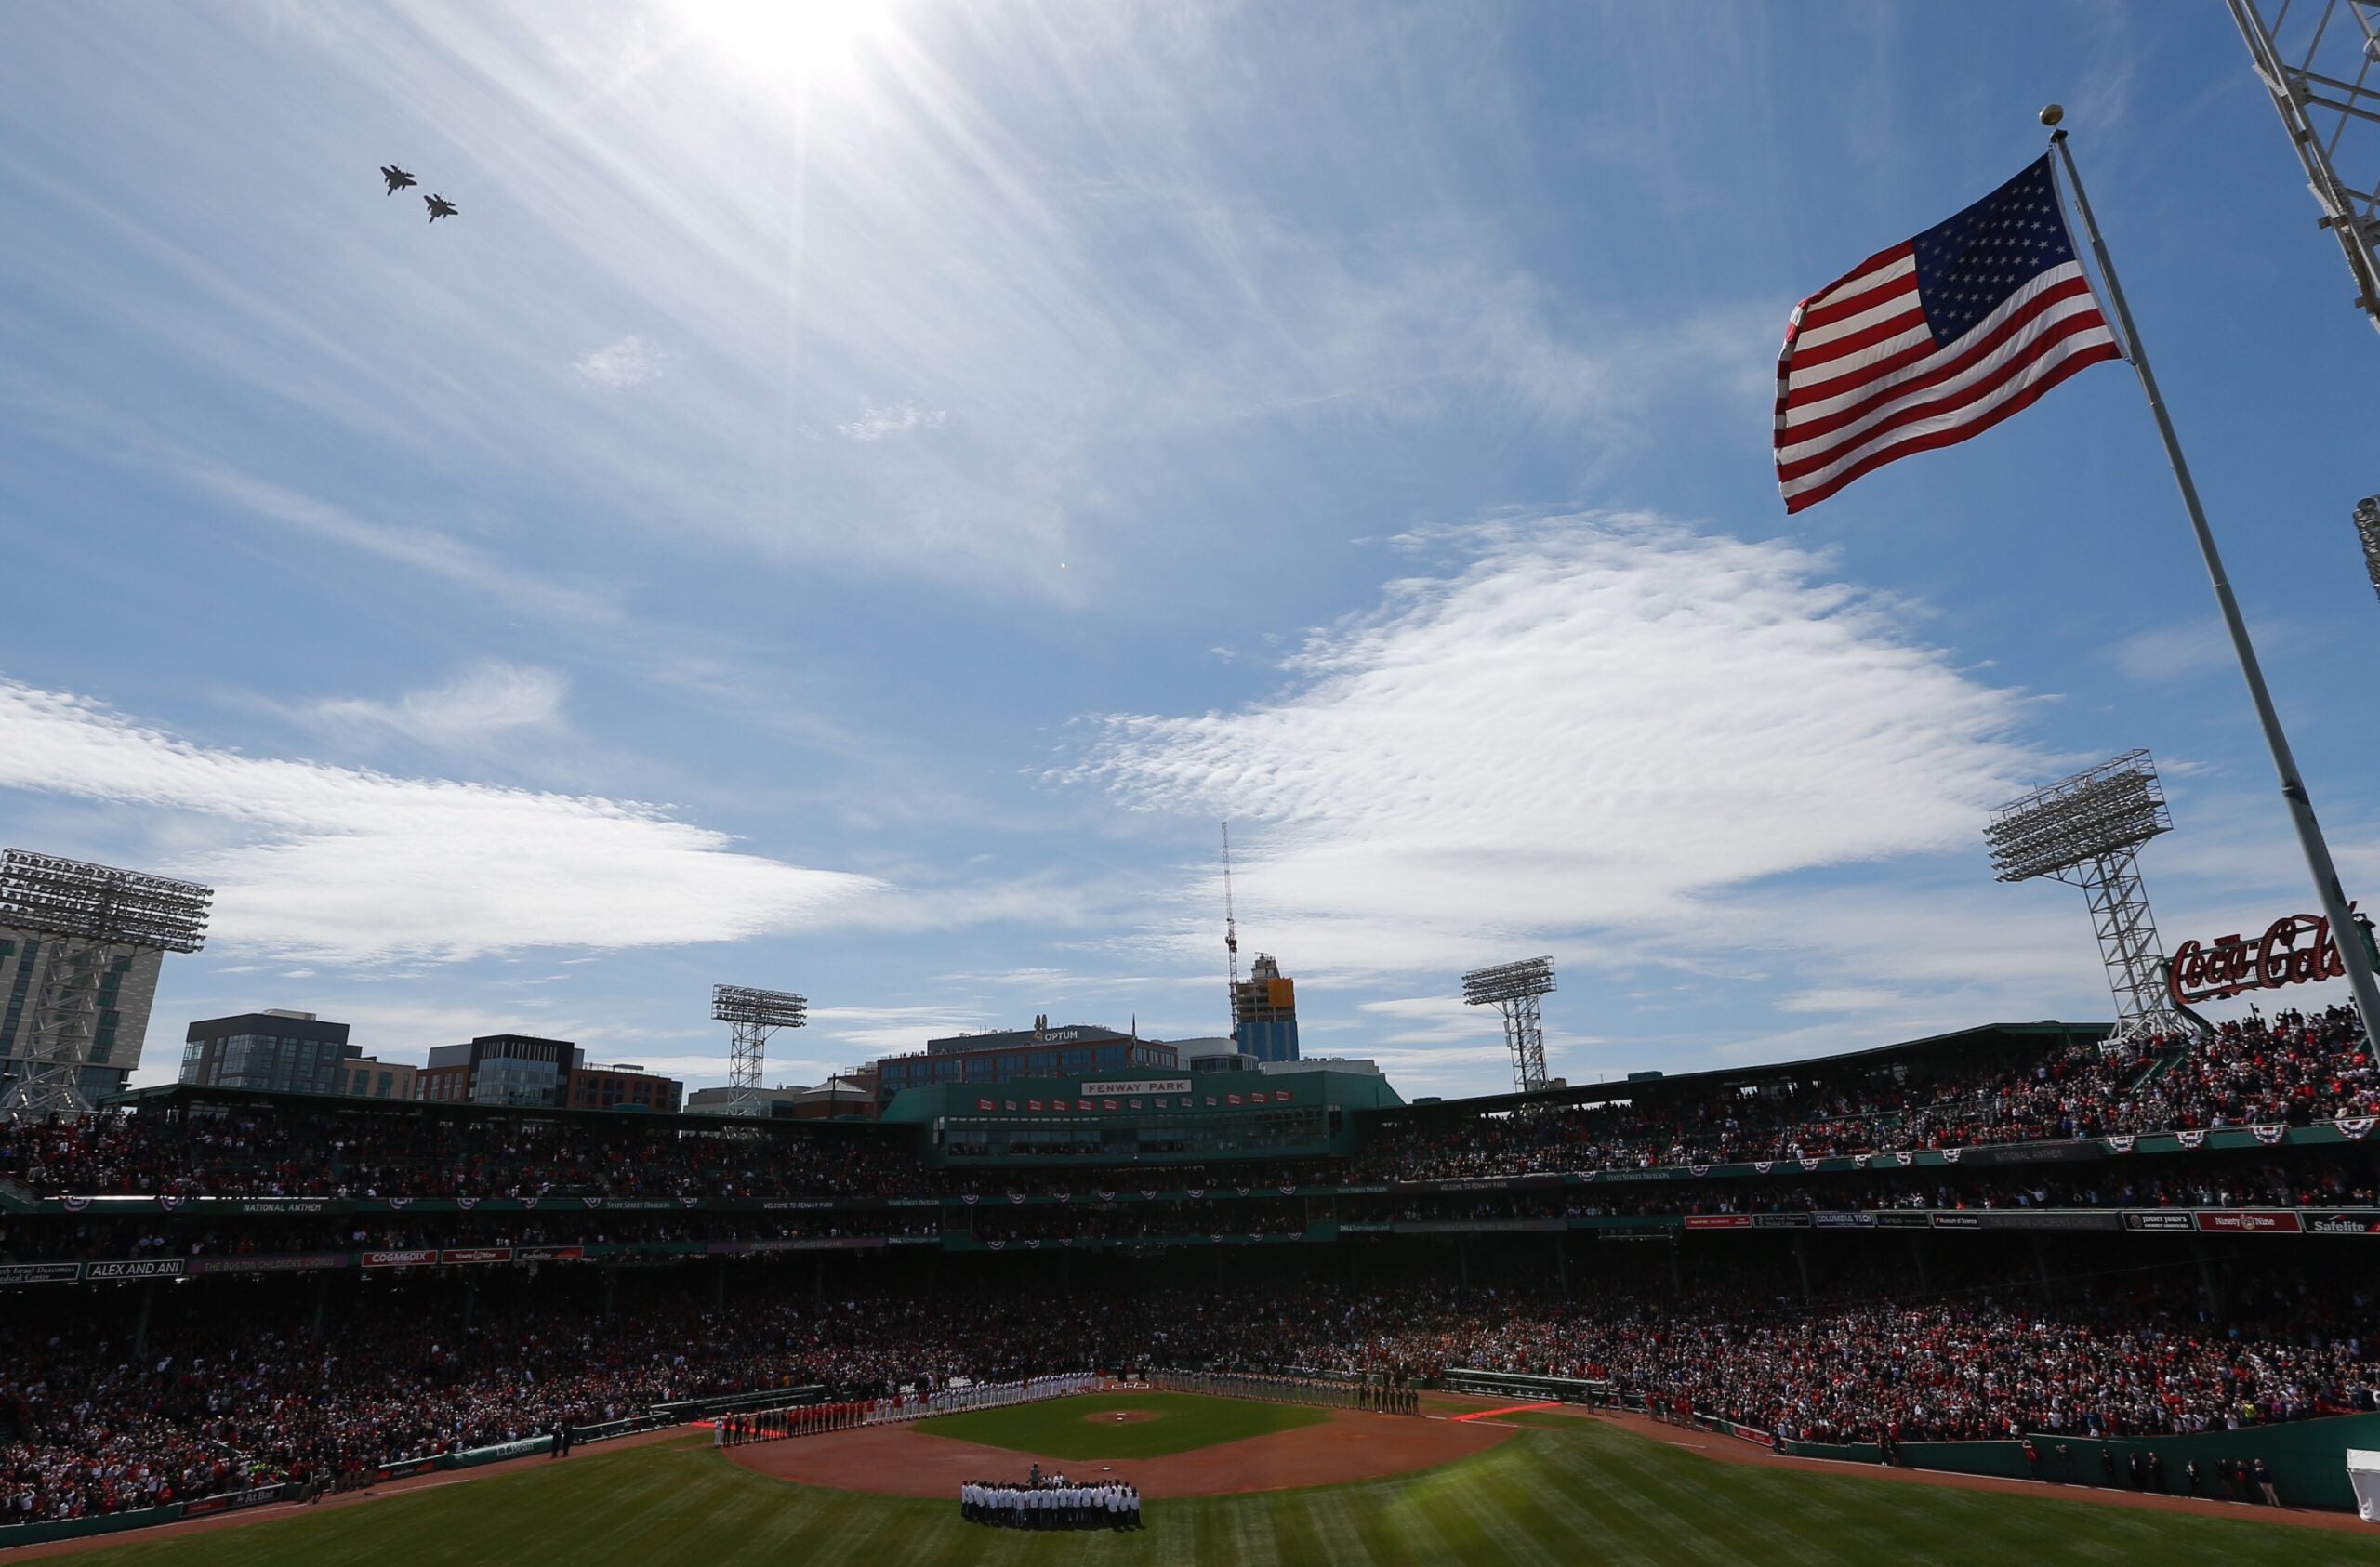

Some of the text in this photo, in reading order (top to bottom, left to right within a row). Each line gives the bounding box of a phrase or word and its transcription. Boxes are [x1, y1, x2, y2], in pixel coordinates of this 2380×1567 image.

[1044, 1030, 1078, 1042] OPTUM
[1089, 1082, 1184, 1093] FENWAY PARK
[1994, 1149, 2064, 1161] NATIONAL ANTHEM
[243, 1203, 322, 1212] NATIONAL ANTHEM
[1816, 1214, 1854, 1223] COLUMBIA
[1855, 1214, 1872, 1223] TECH
[2214, 1216, 2275, 1227] Ninety Nine
[2313, 1221, 2365, 1231] Safelite
[372, 1252, 427, 1263] COGMEDIX
[522, 1252, 552, 1260] Safelite
[13, 1266, 35, 1274] Israel
[92, 1262, 180, 1276] ALEX AND ANI
[205, 1262, 222, 1271] THE
[223, 1261, 256, 1271] BOSTON
[0, 1273, 22, 1282] edical
[245, 1490, 275, 1503] At Bat
